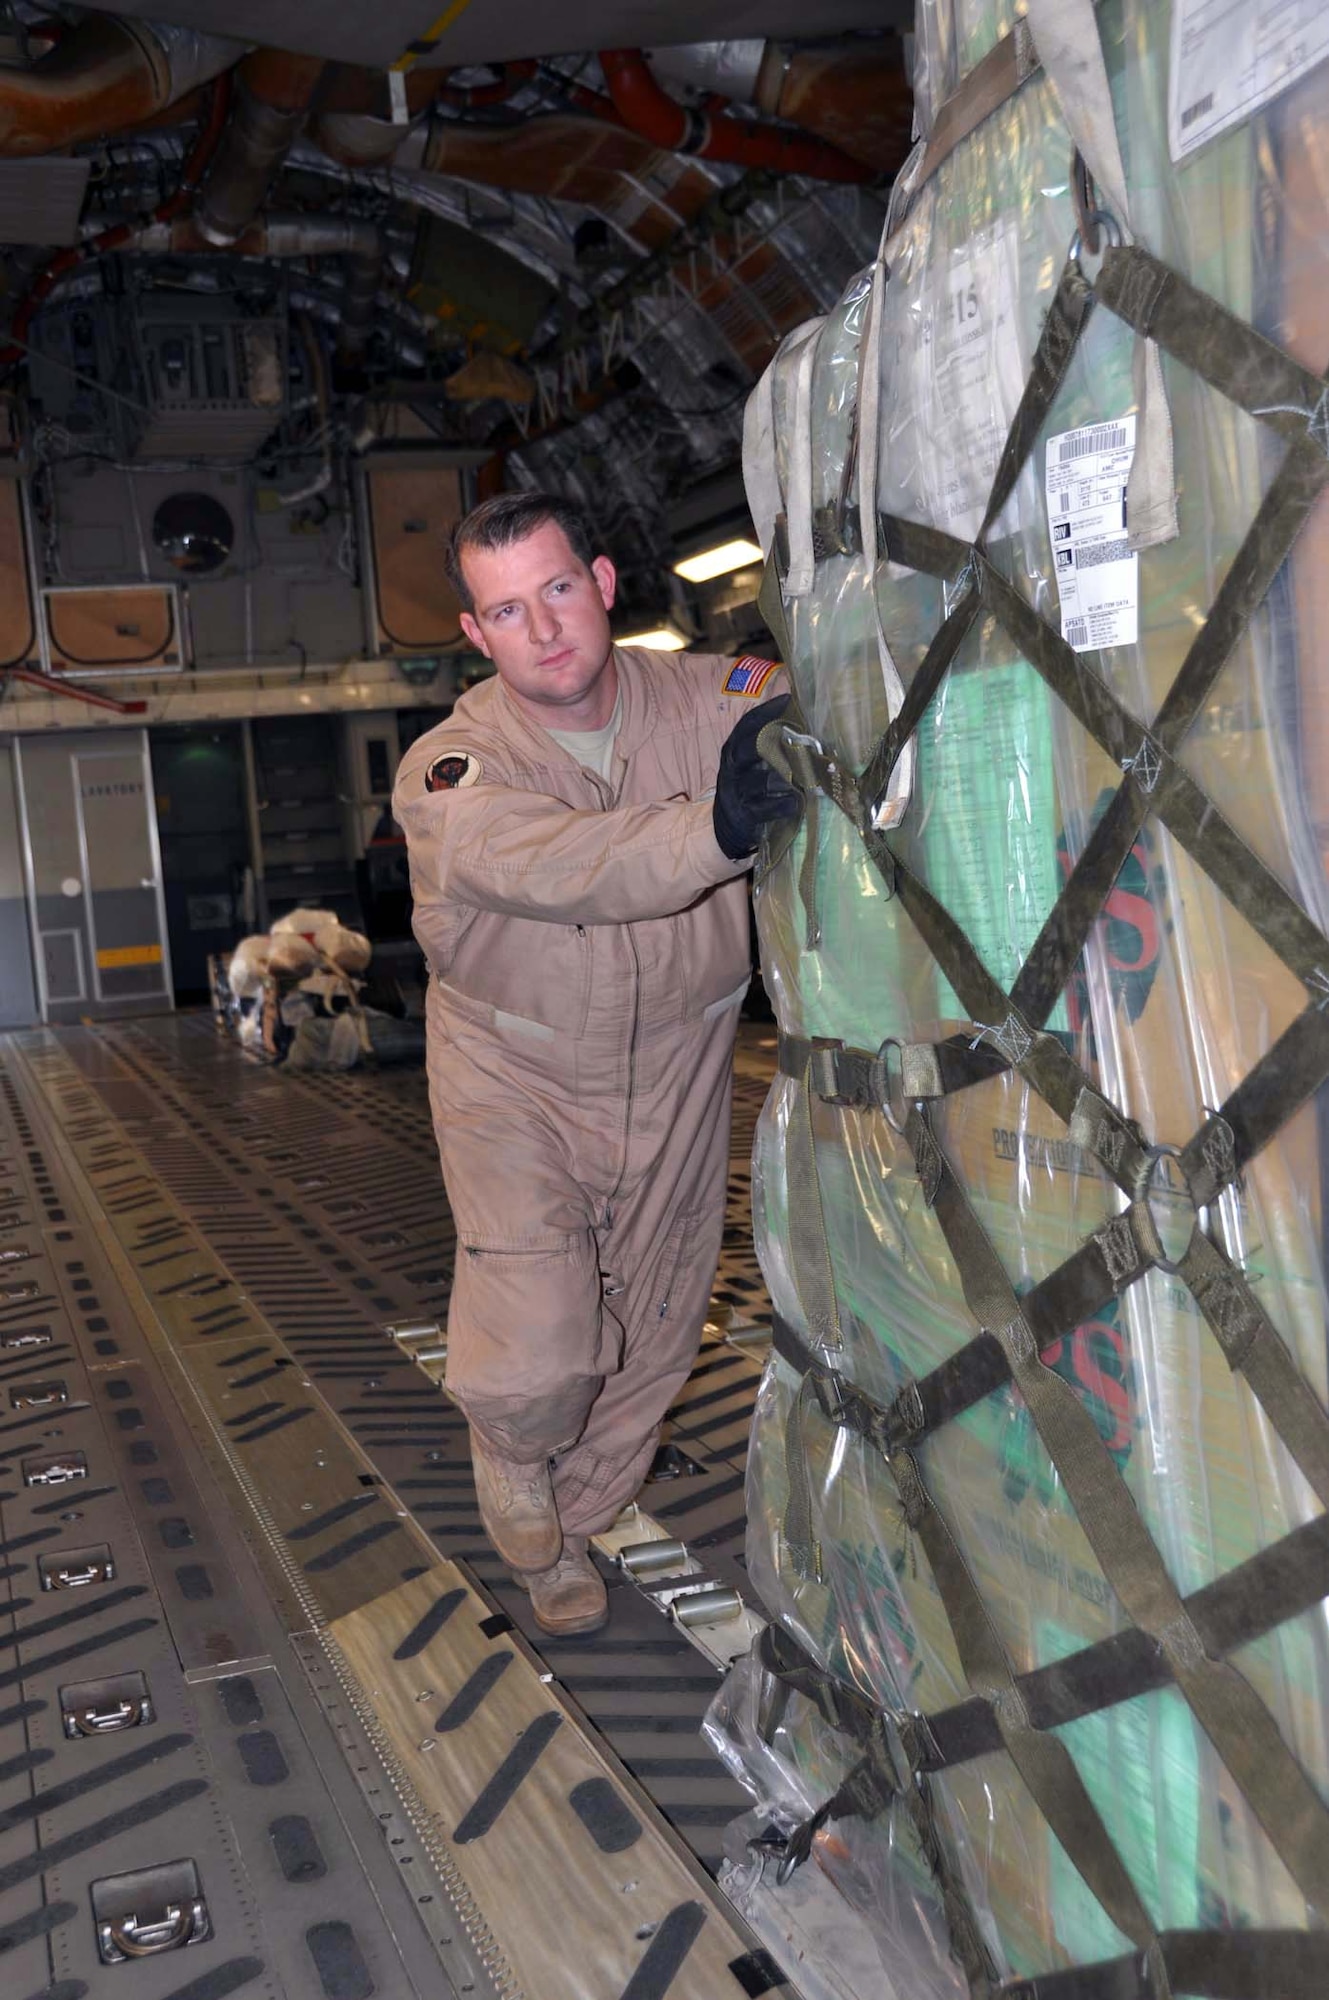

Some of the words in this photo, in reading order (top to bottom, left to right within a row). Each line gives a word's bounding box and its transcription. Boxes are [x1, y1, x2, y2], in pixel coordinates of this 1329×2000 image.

[1054, 526, 1067, 540] RIV
[1116, 600, 1129, 608] DATA
[81, 782, 144, 798] LAVATORY
